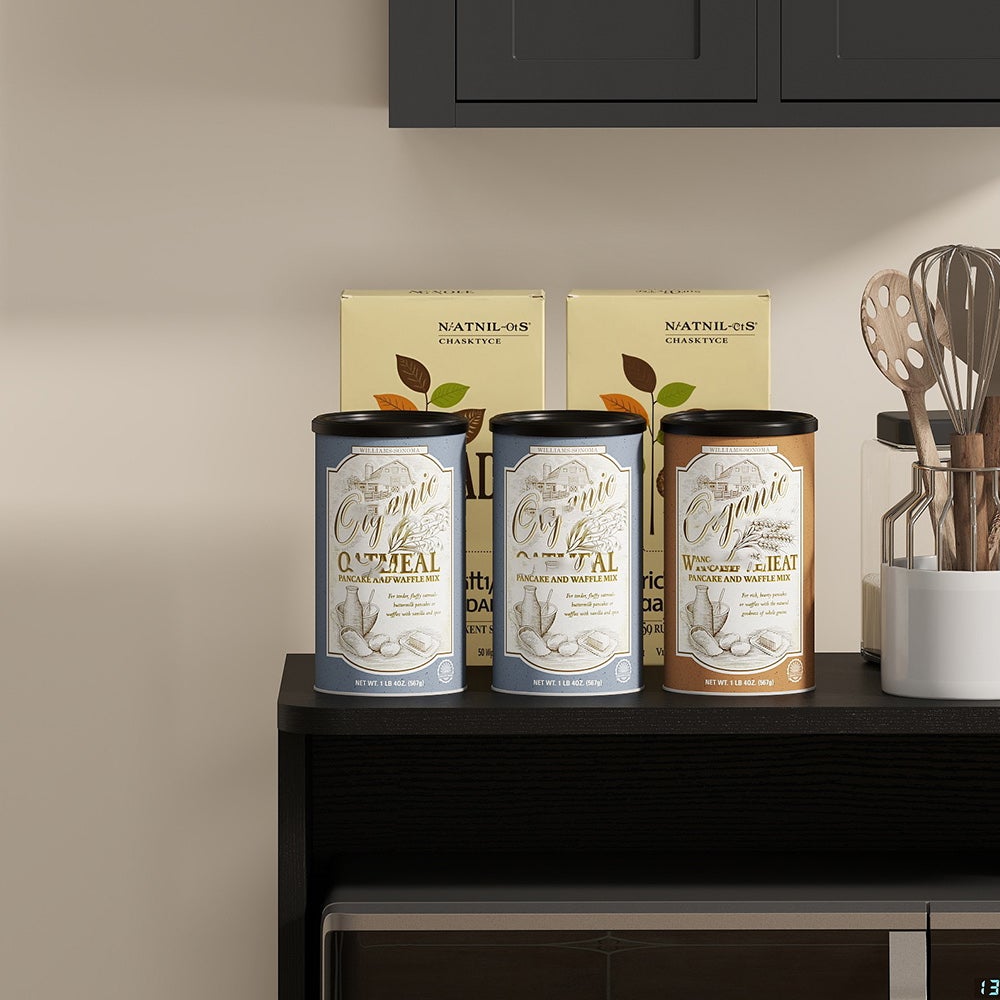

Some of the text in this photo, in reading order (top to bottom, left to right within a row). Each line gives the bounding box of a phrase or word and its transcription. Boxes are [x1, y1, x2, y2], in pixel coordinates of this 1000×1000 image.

[338, 575, 372, 583] PANCAKE
[516, 574, 549, 583] PANCAKE
[571, 575, 602, 583] WAFFLE
[688, 574, 722, 582] PANCAKE
